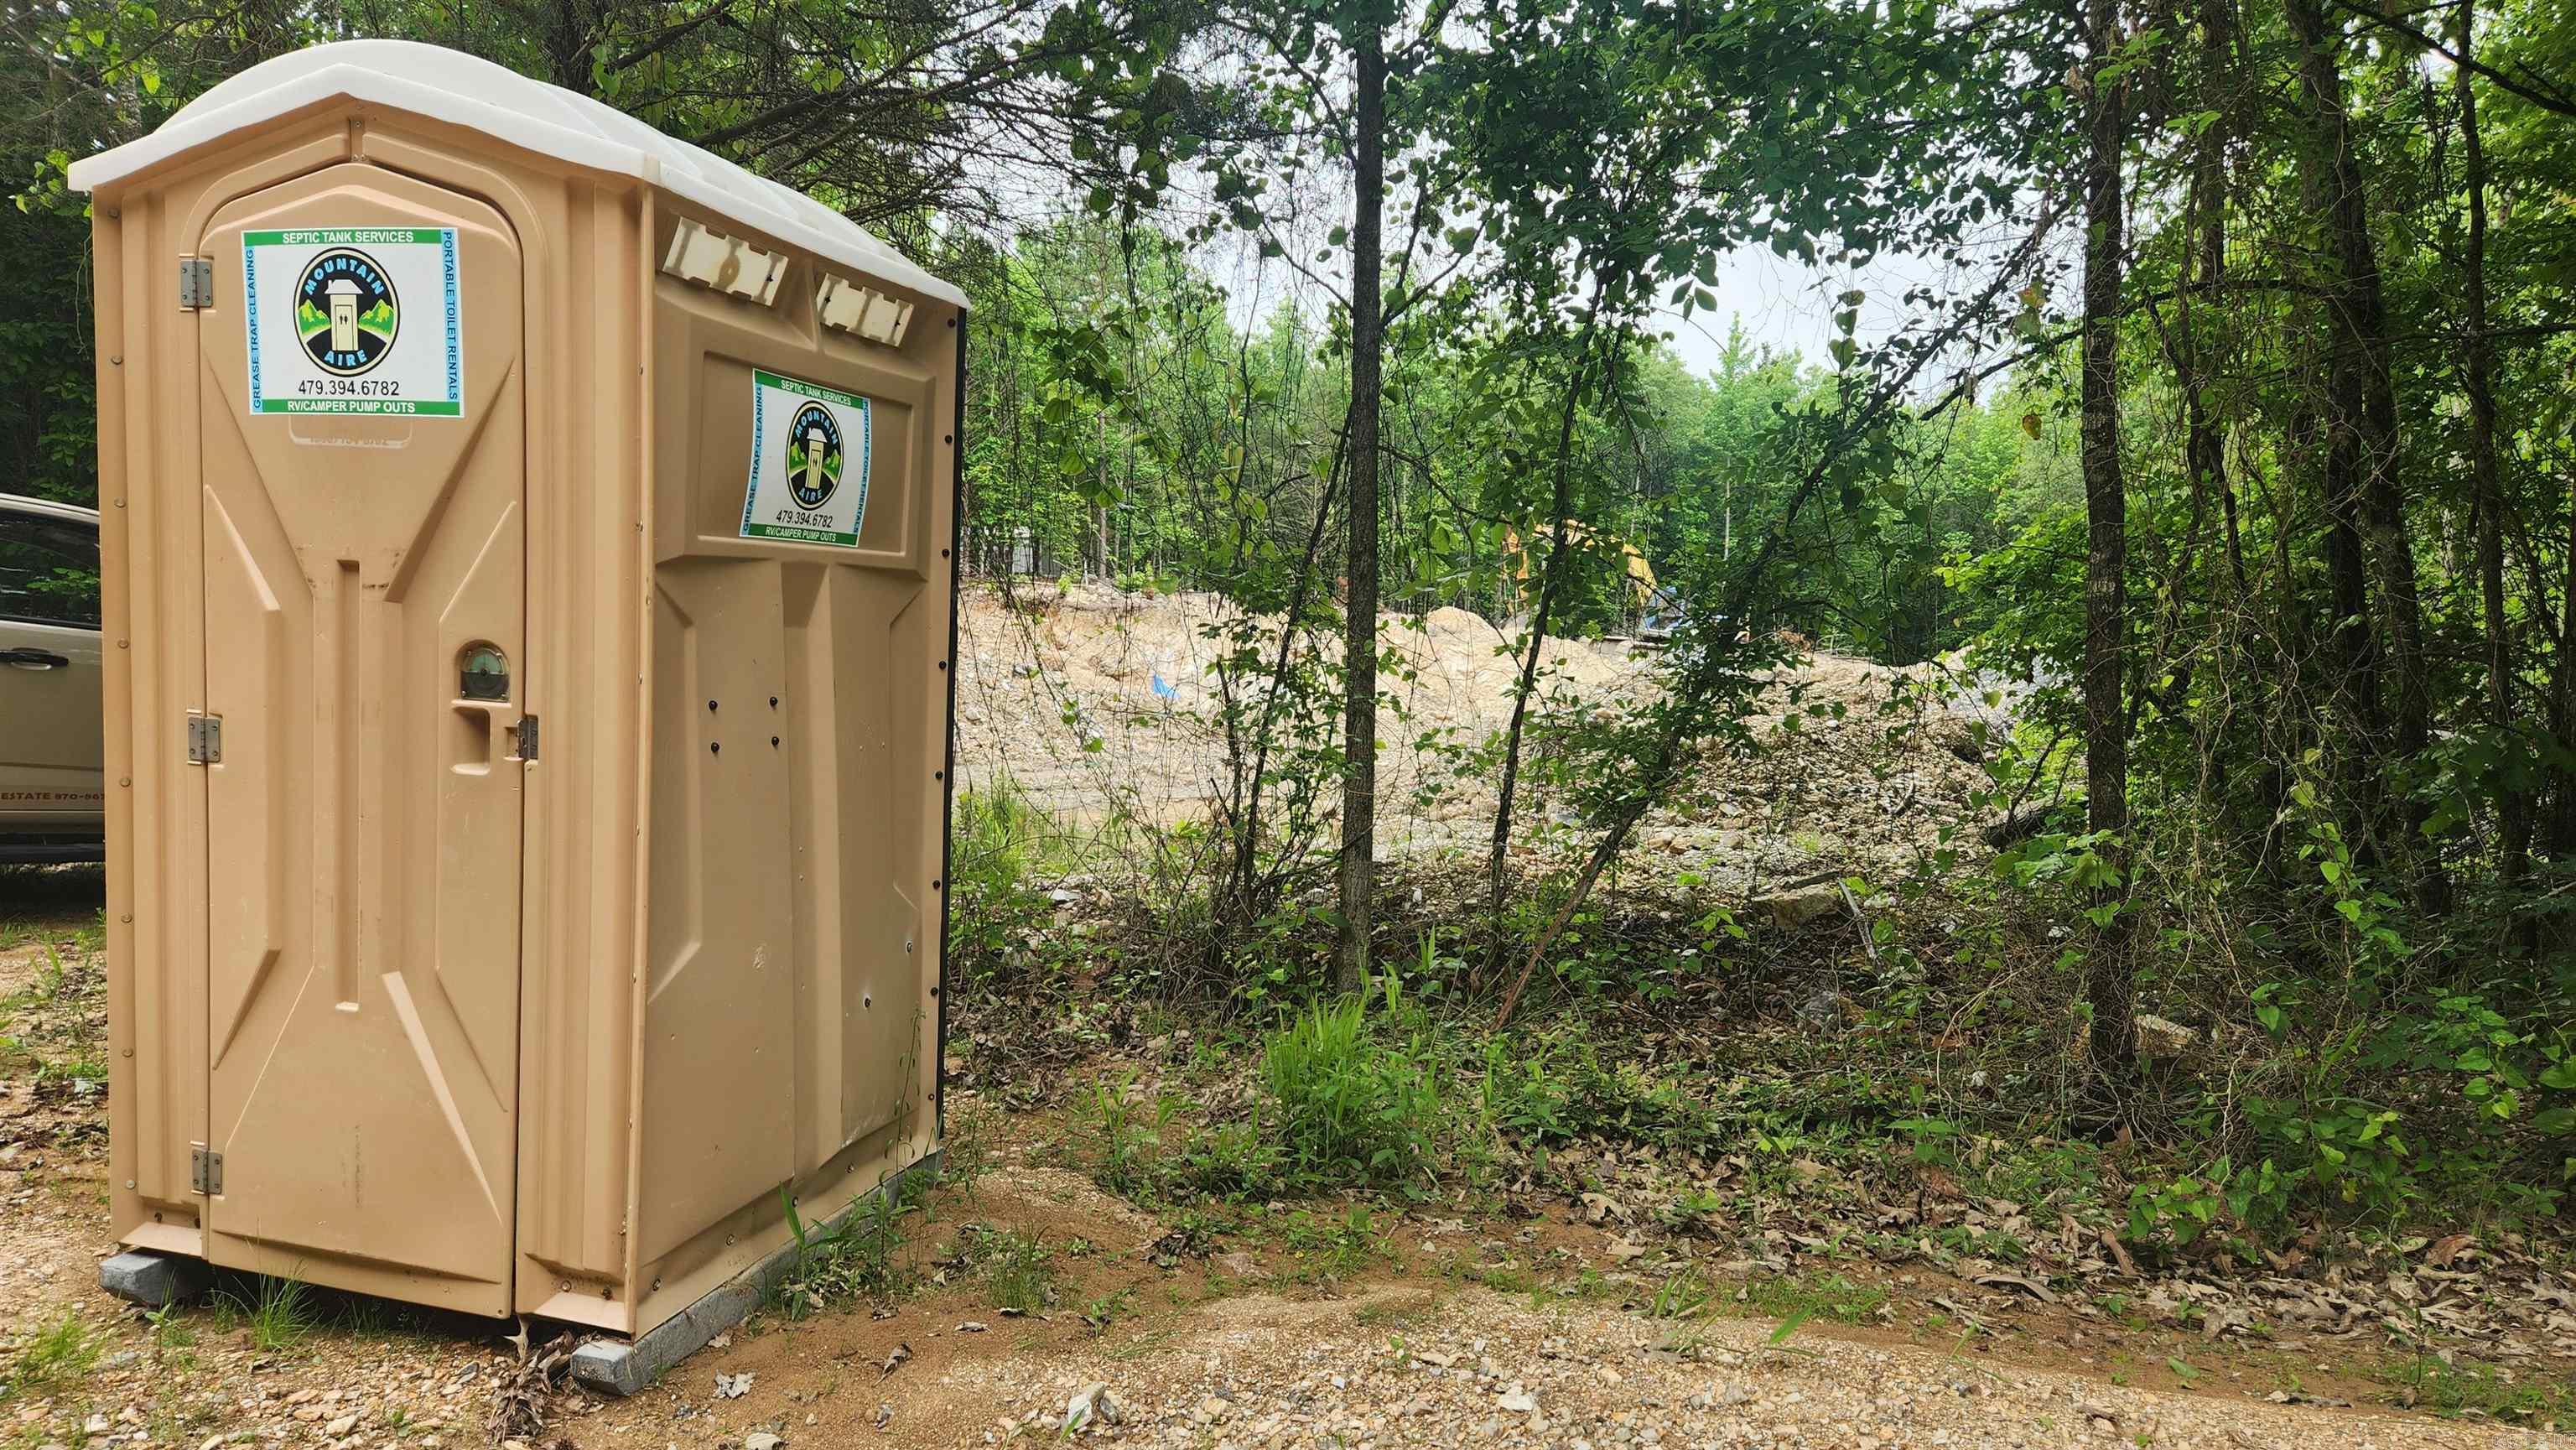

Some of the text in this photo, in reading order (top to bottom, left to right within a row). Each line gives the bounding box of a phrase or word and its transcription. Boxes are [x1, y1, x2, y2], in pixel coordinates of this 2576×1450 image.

[283, 231, 414, 244] SEPTIC TANK SERVICES
[304, 257, 385, 295] MOUNTAIN
[444, 231, 458, 400] PORTABLE TOILET RENTALS
[246, 250, 262, 408] GREASE TRAP CLEANING
[325, 350, 367, 366] AIRE
[299, 380, 400, 396] 479.394.6782
[781, 380, 851, 406] SEPTIC TANK SERVICES
[288, 402, 416, 413] RV/CAMPER PUMP OUTS
[795, 410, 839, 445] MOUNTAIN
[744, 486, 756, 531] GREASE
[752, 450, 761, 479] TRAP
[798, 489, 823, 502] AIRE
[776, 509, 834, 528] 479.394.6782
[765, 526, 837, 542] RV/CAMPER PUMP OUTS
[1, 792, 51, 800] ESTATE
